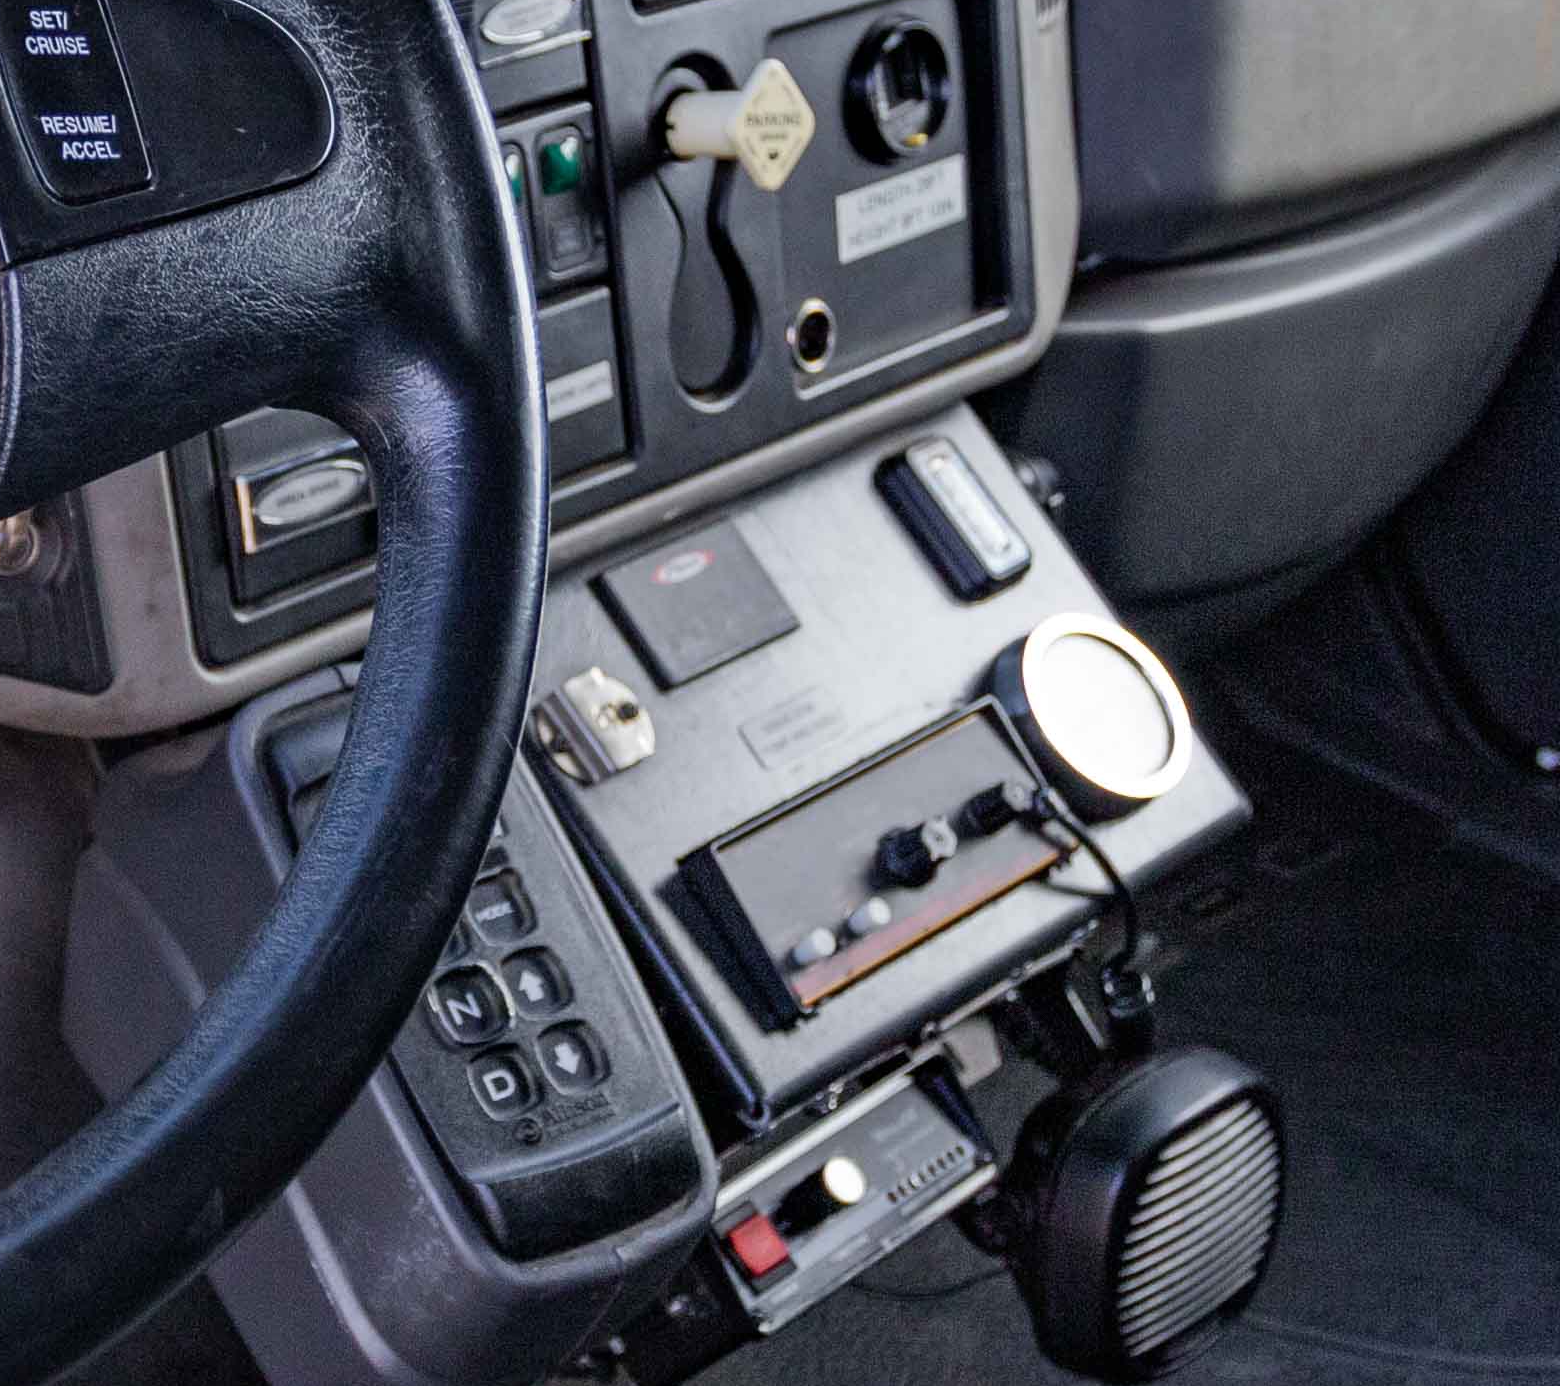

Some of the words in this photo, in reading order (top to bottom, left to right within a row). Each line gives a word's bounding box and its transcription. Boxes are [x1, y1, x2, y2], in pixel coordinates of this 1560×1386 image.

[30, 10, 68, 31] SET/
[25, 35, 91, 56] CRUISE
[40, 114, 117, 135] RESUME/
[446, 992, 483, 1026] N
[482, 1069, 517, 1102] D
